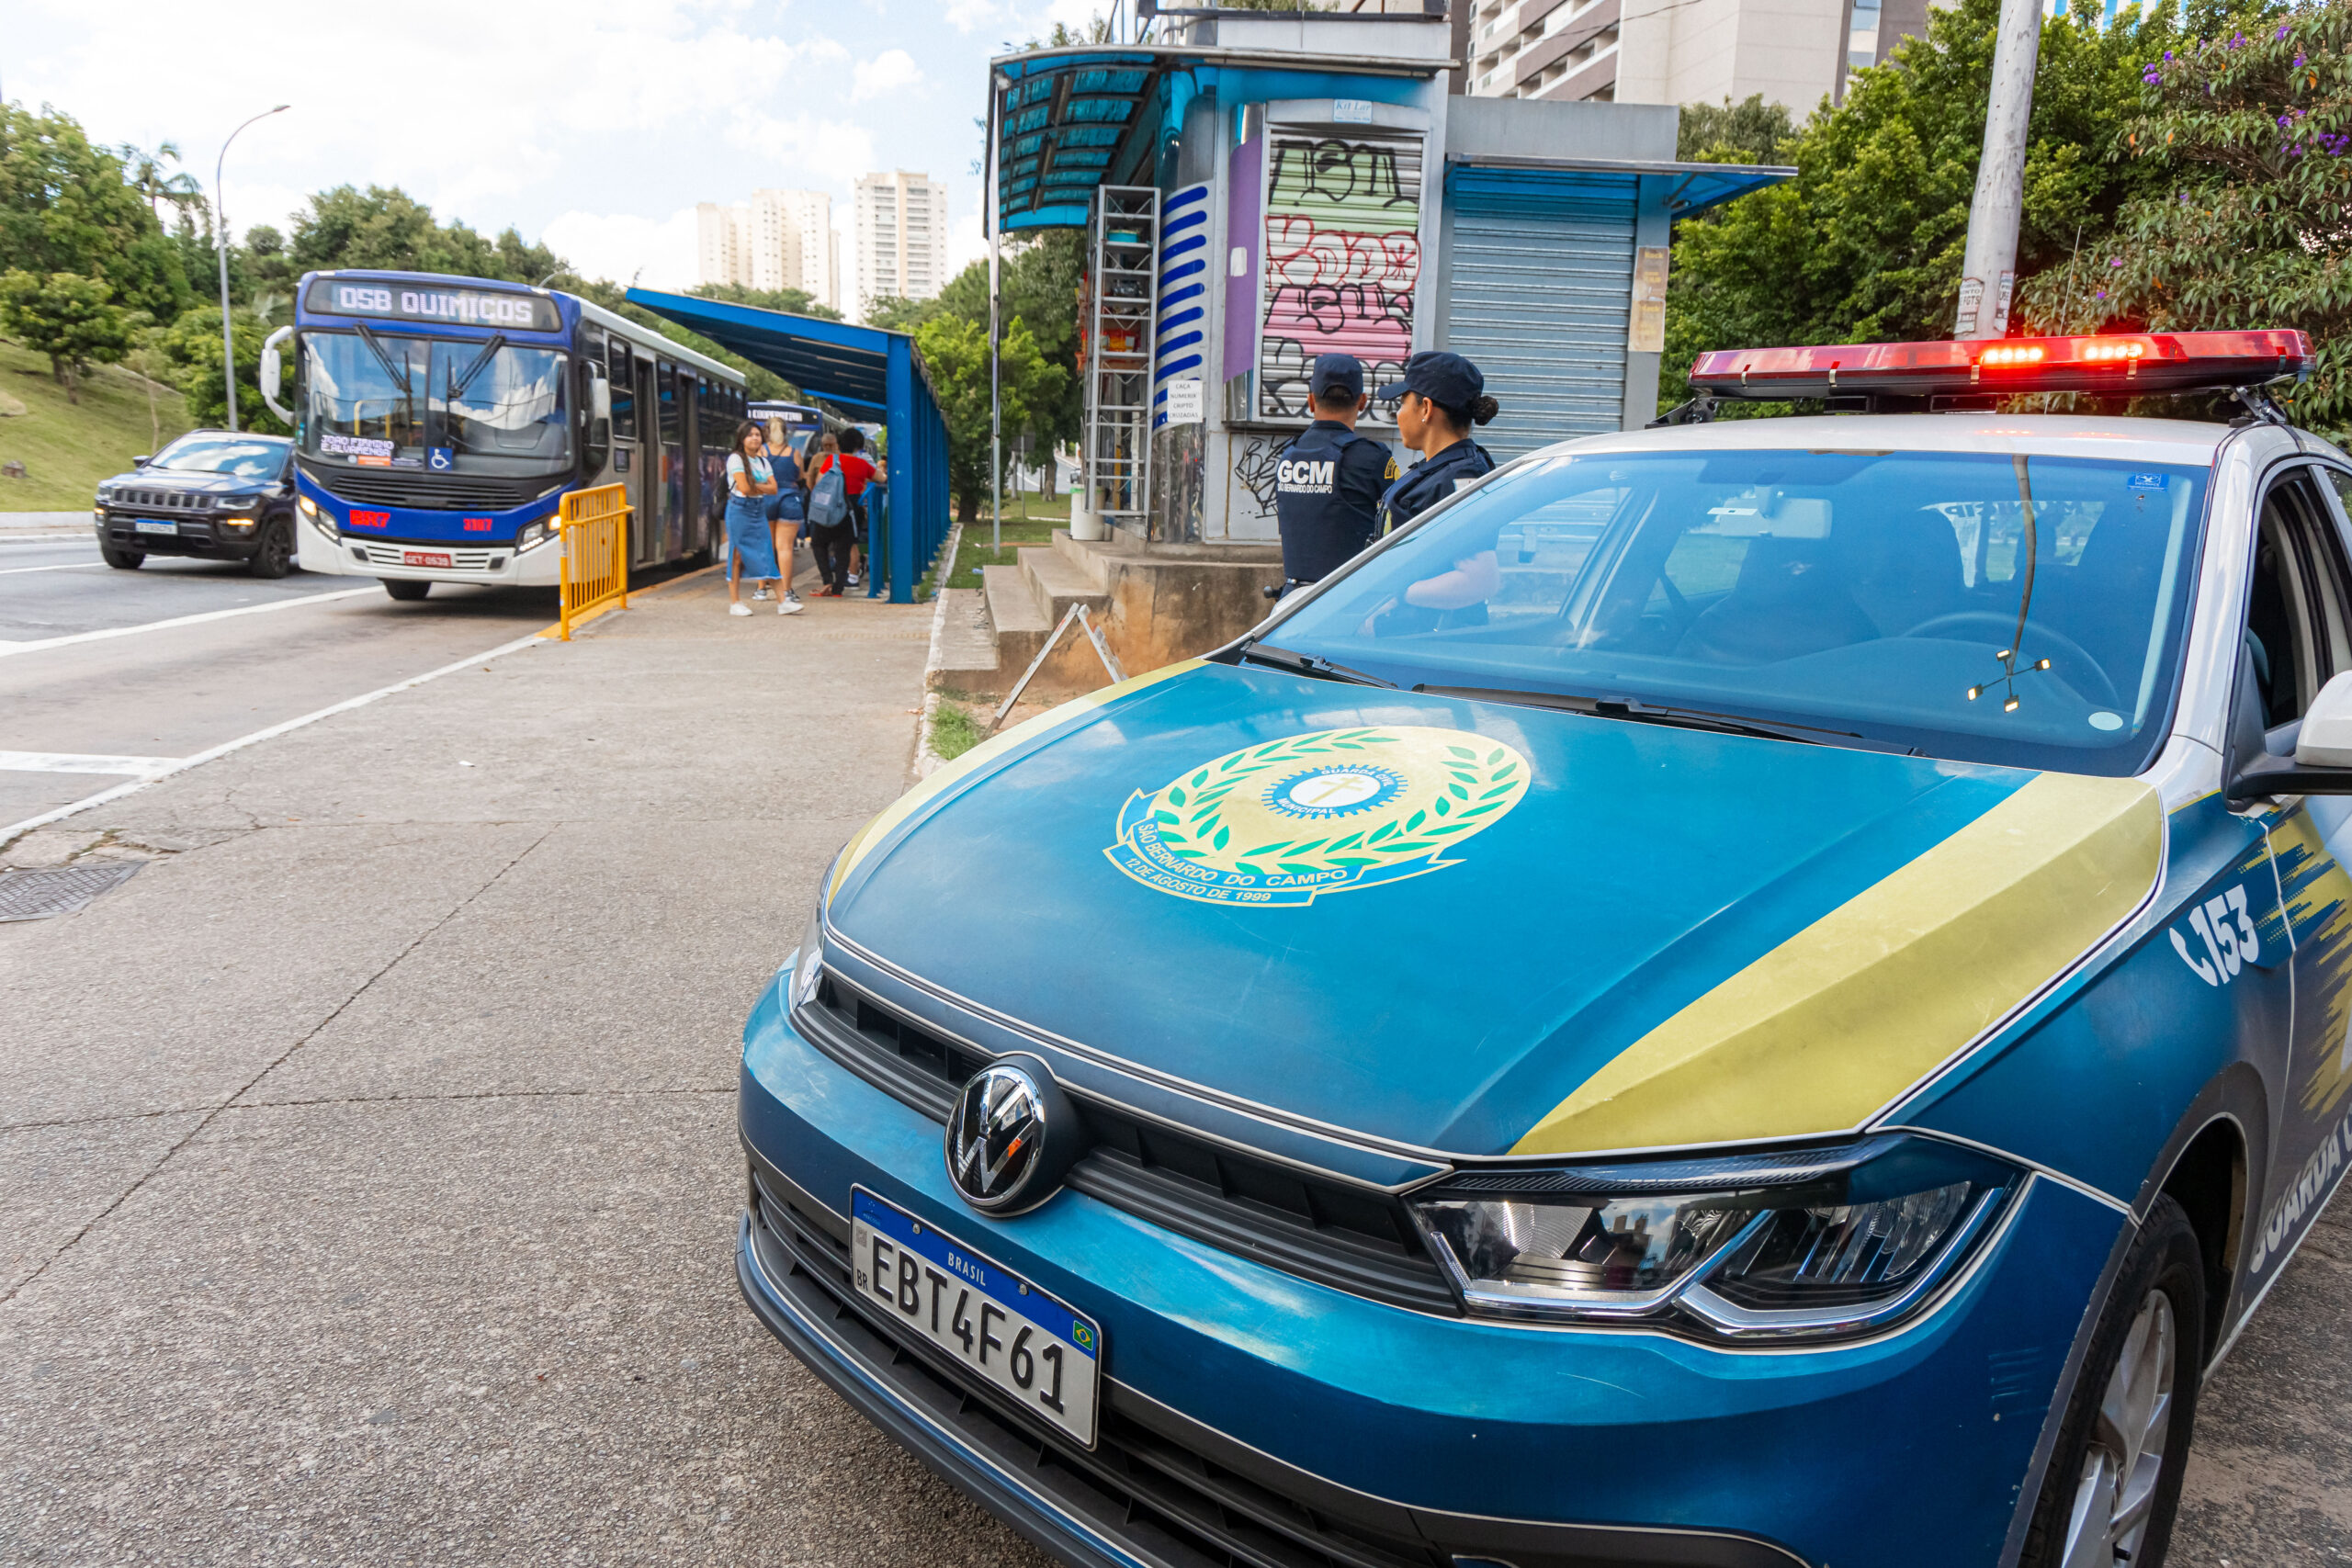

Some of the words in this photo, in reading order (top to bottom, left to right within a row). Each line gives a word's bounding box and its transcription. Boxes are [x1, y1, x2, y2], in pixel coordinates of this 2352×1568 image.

[401, 291, 533, 322] QUIMICOS
[1277, 460, 1335, 485] GCM
[1321, 768, 1376, 776] GUARDA
[1276, 797, 1337, 814] MUNICIPAL
[1138, 823, 1158, 843] SÃO
[1145, 842, 1218, 881] BERNARDO
[1125, 858, 1141, 868] 12
[1134, 864, 1156, 877] DE
[1148, 874, 1207, 895] AGOSTO
[1206, 888, 1232, 899] DE
[1235, 891, 1272, 902] 1999
[1223, 874, 1256, 886] DO
[1265, 869, 1348, 886] CAMPO
[2188, 884, 2259, 985] 153
[856, 1269, 869, 1292] BR
[947, 1251, 987, 1287] BRASIL
[873, 1234, 1065, 1416] EBT4F61
